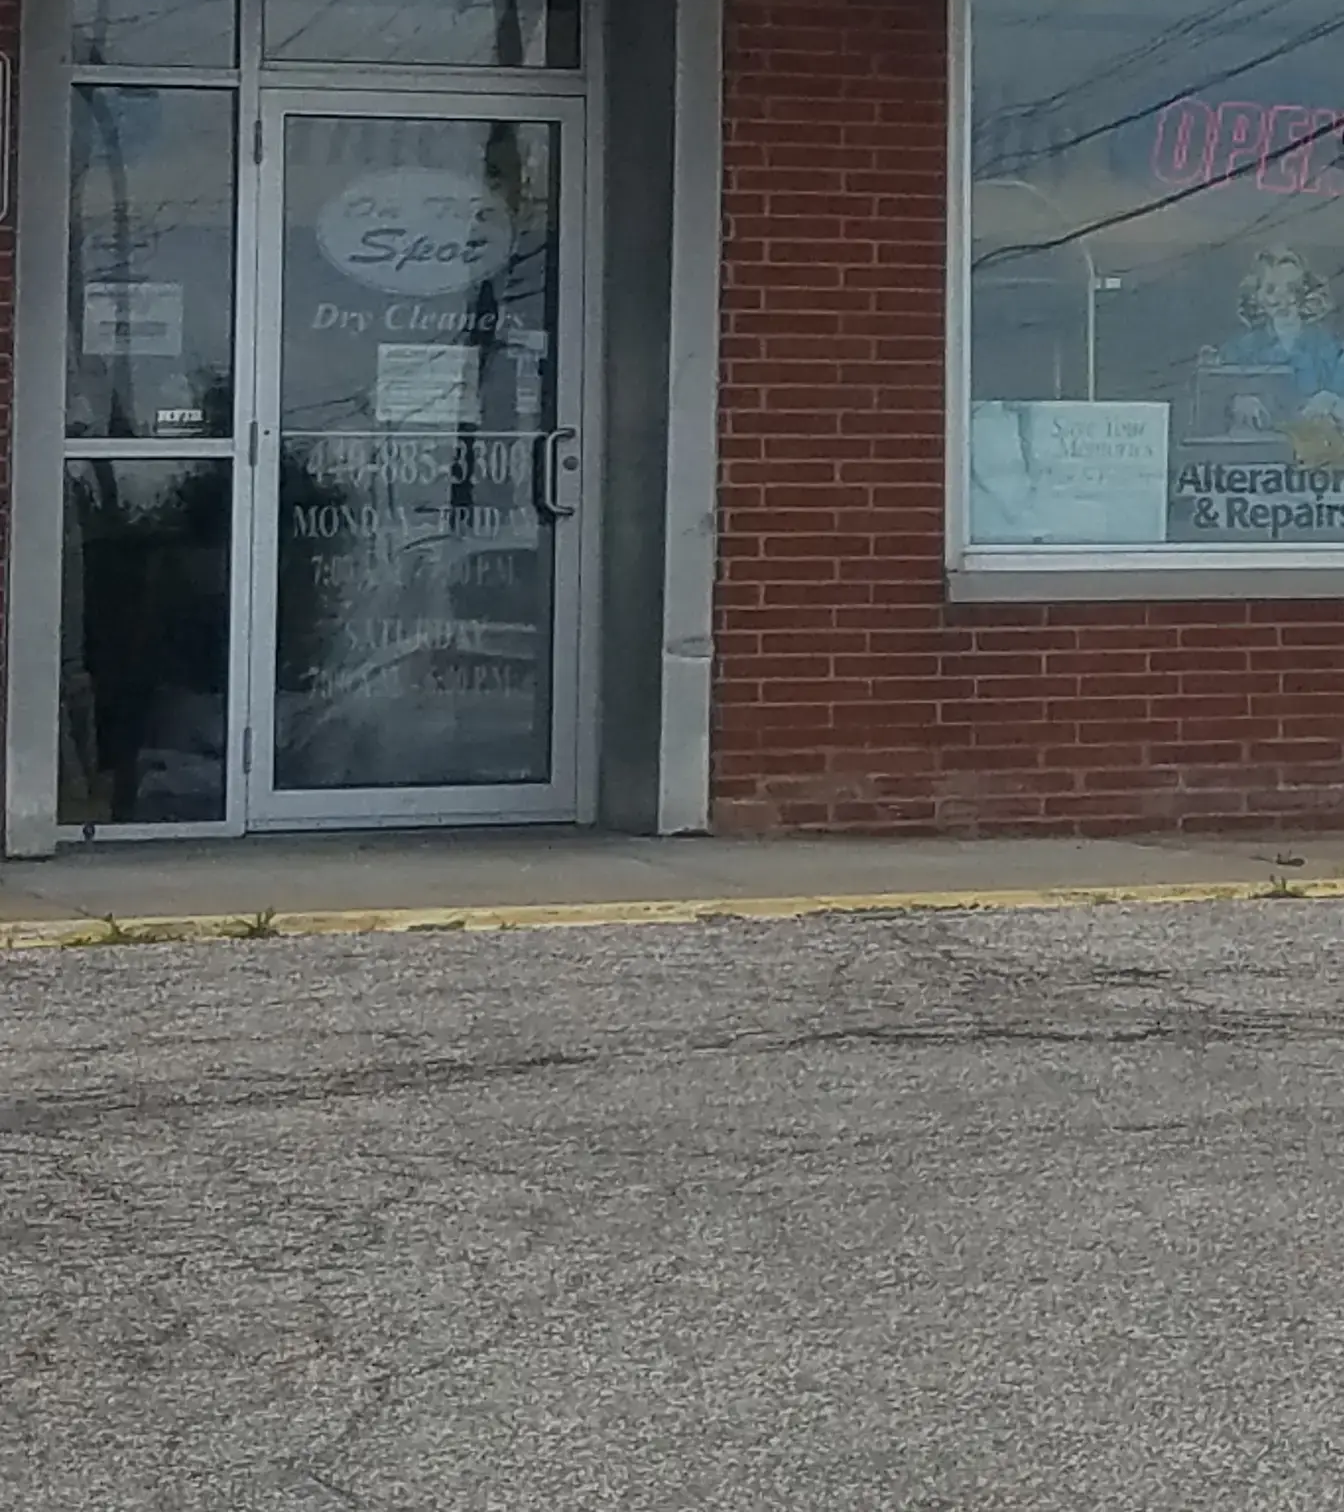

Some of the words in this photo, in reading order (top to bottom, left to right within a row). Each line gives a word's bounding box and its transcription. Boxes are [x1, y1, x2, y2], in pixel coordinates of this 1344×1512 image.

[346, 227, 493, 272] Spot
[312, 301, 375, 335] Dry
[384, 300, 524, 333] Cleaners
[1194, 496, 1220, 530] &
